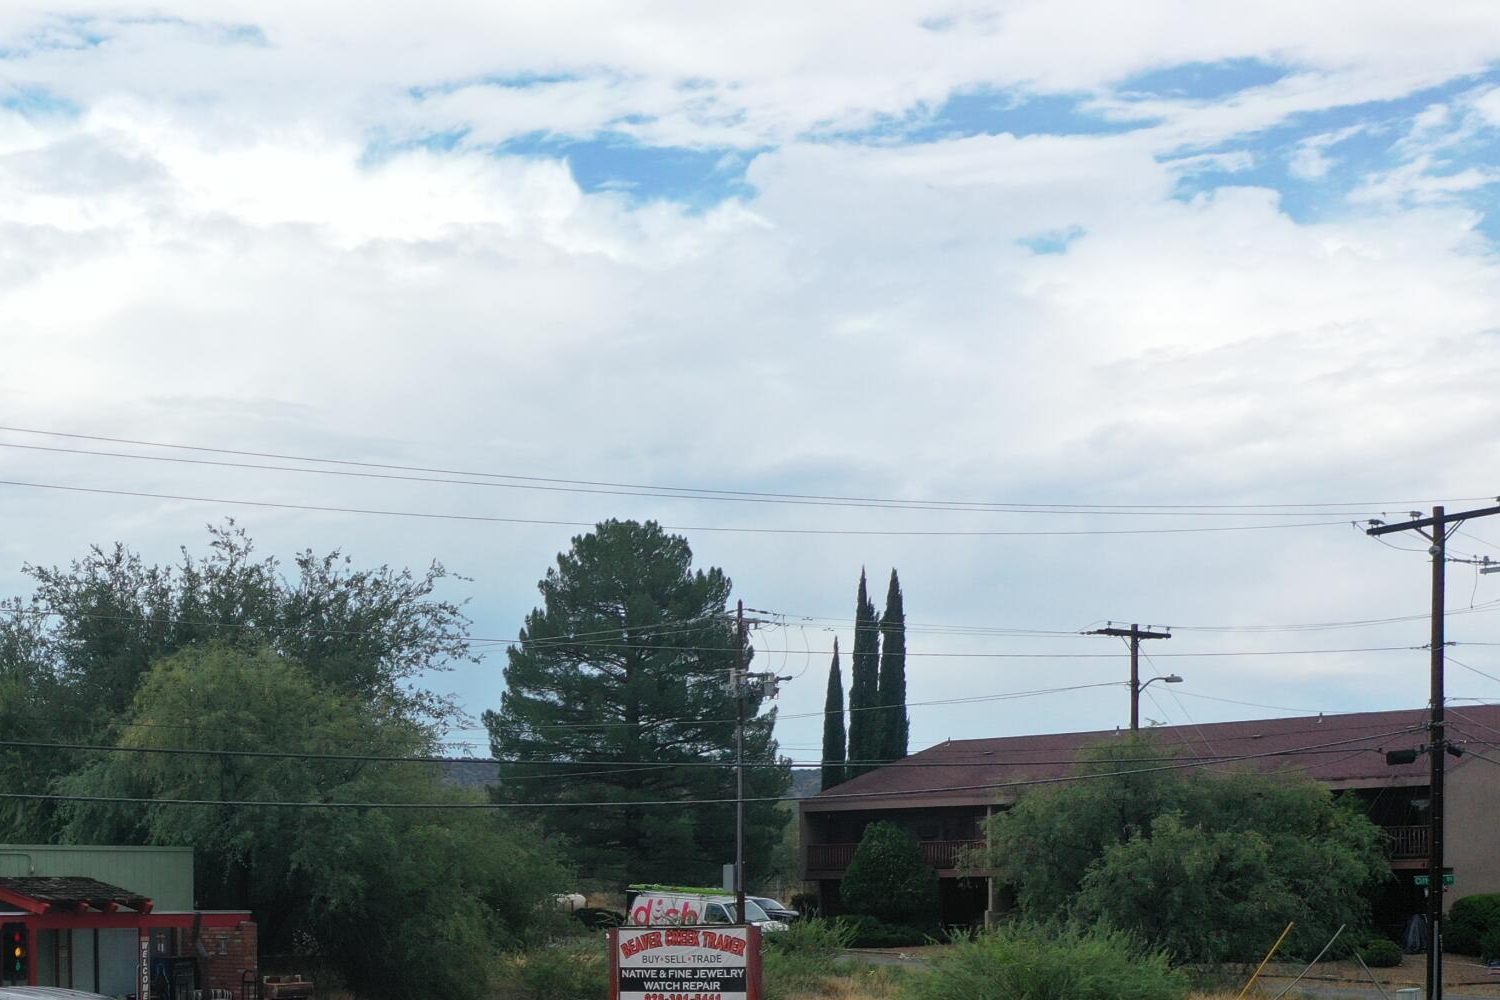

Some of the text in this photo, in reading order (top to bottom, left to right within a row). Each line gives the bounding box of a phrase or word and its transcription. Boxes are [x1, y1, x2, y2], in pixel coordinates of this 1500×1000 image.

[634, 899, 698, 926] dish
[620, 929, 746, 958] BEAVER CREEK TRADER
[642, 954, 722, 963] BUY SELL TRADE
[621, 969, 744, 978] NATIVE & FINE JEWELRY
[643, 981, 721, 990] WATCH REPAIR
